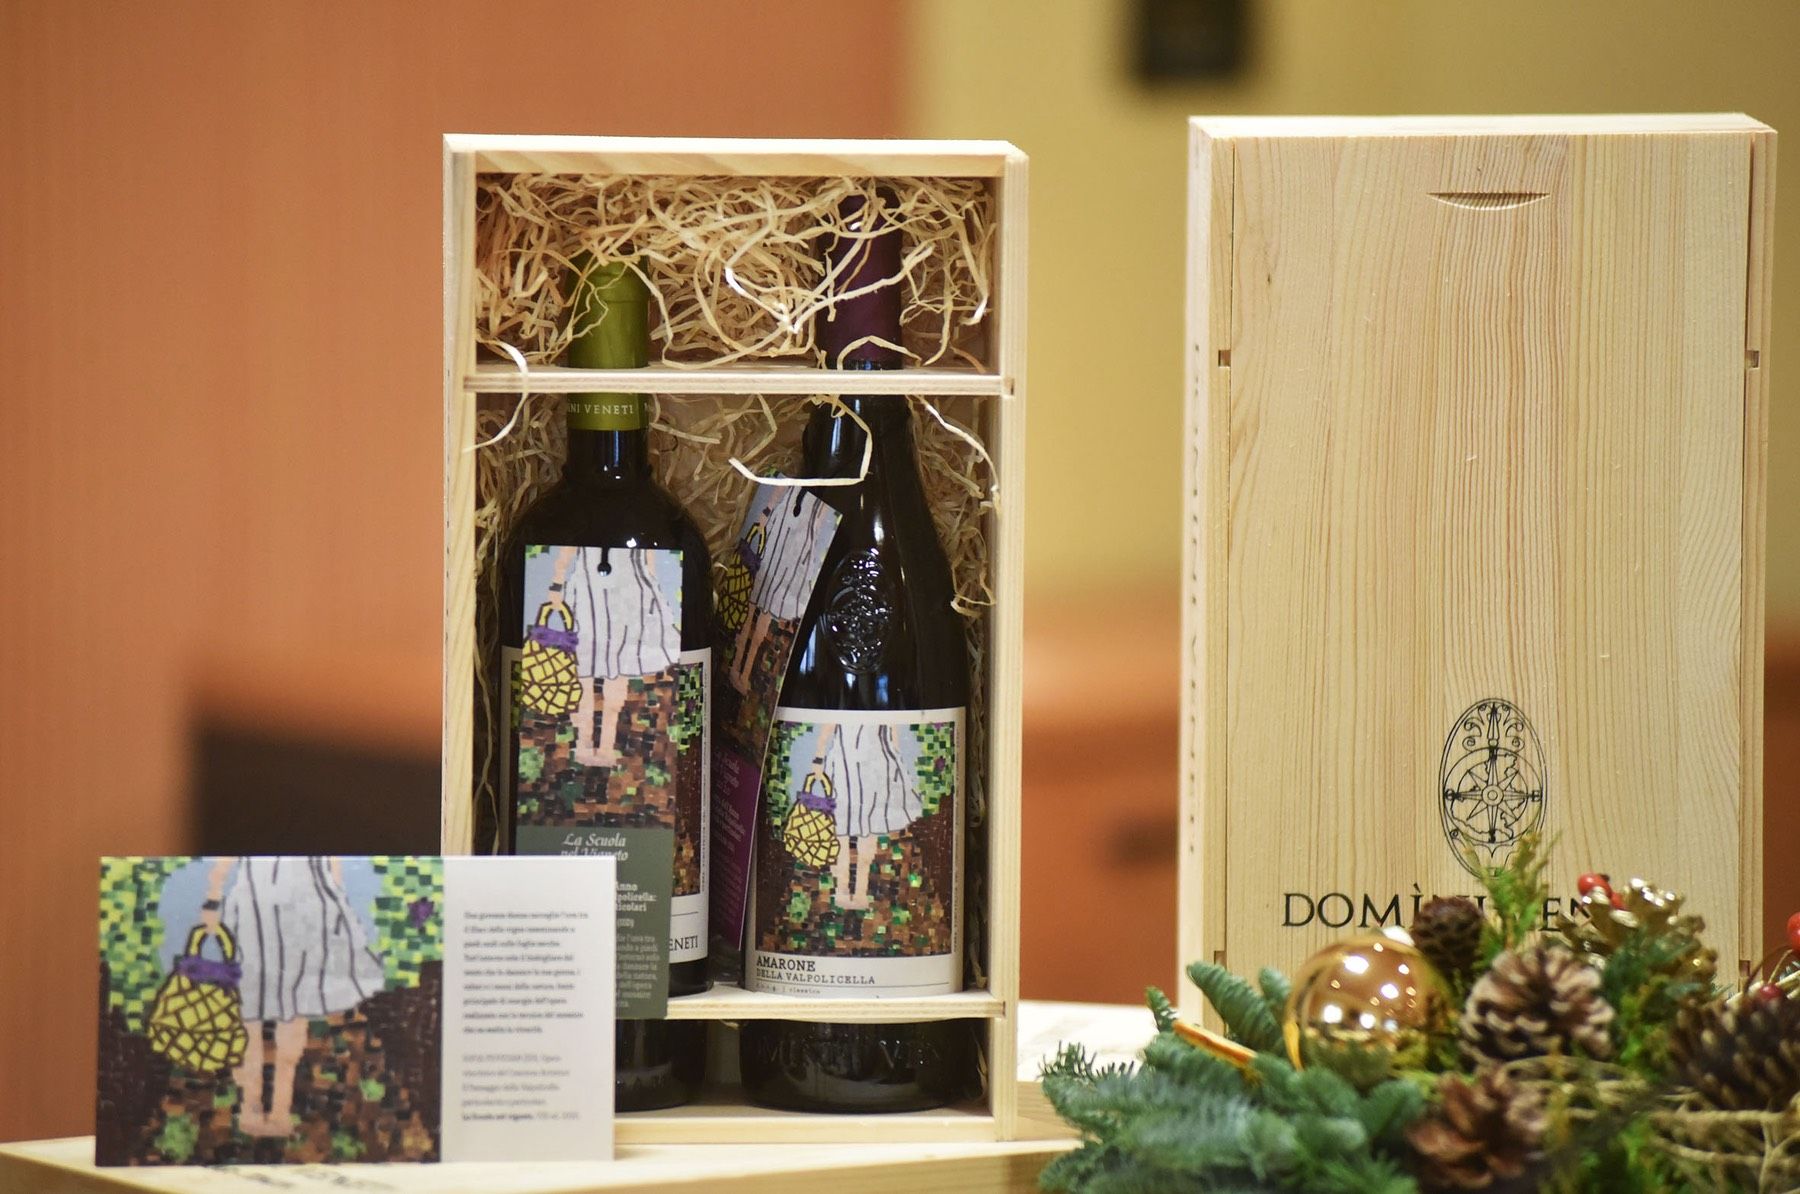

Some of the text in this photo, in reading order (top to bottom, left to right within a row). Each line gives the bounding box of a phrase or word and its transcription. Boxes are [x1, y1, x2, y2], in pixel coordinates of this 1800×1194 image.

[584, 404, 634, 415] VENETI
[563, 832, 626, 847] La Scuola
[669, 935, 698, 951] ENETI
[756, 956, 816, 972] AMARONE
[756, 967, 876, 985] DELLA VALPOLICELLA
